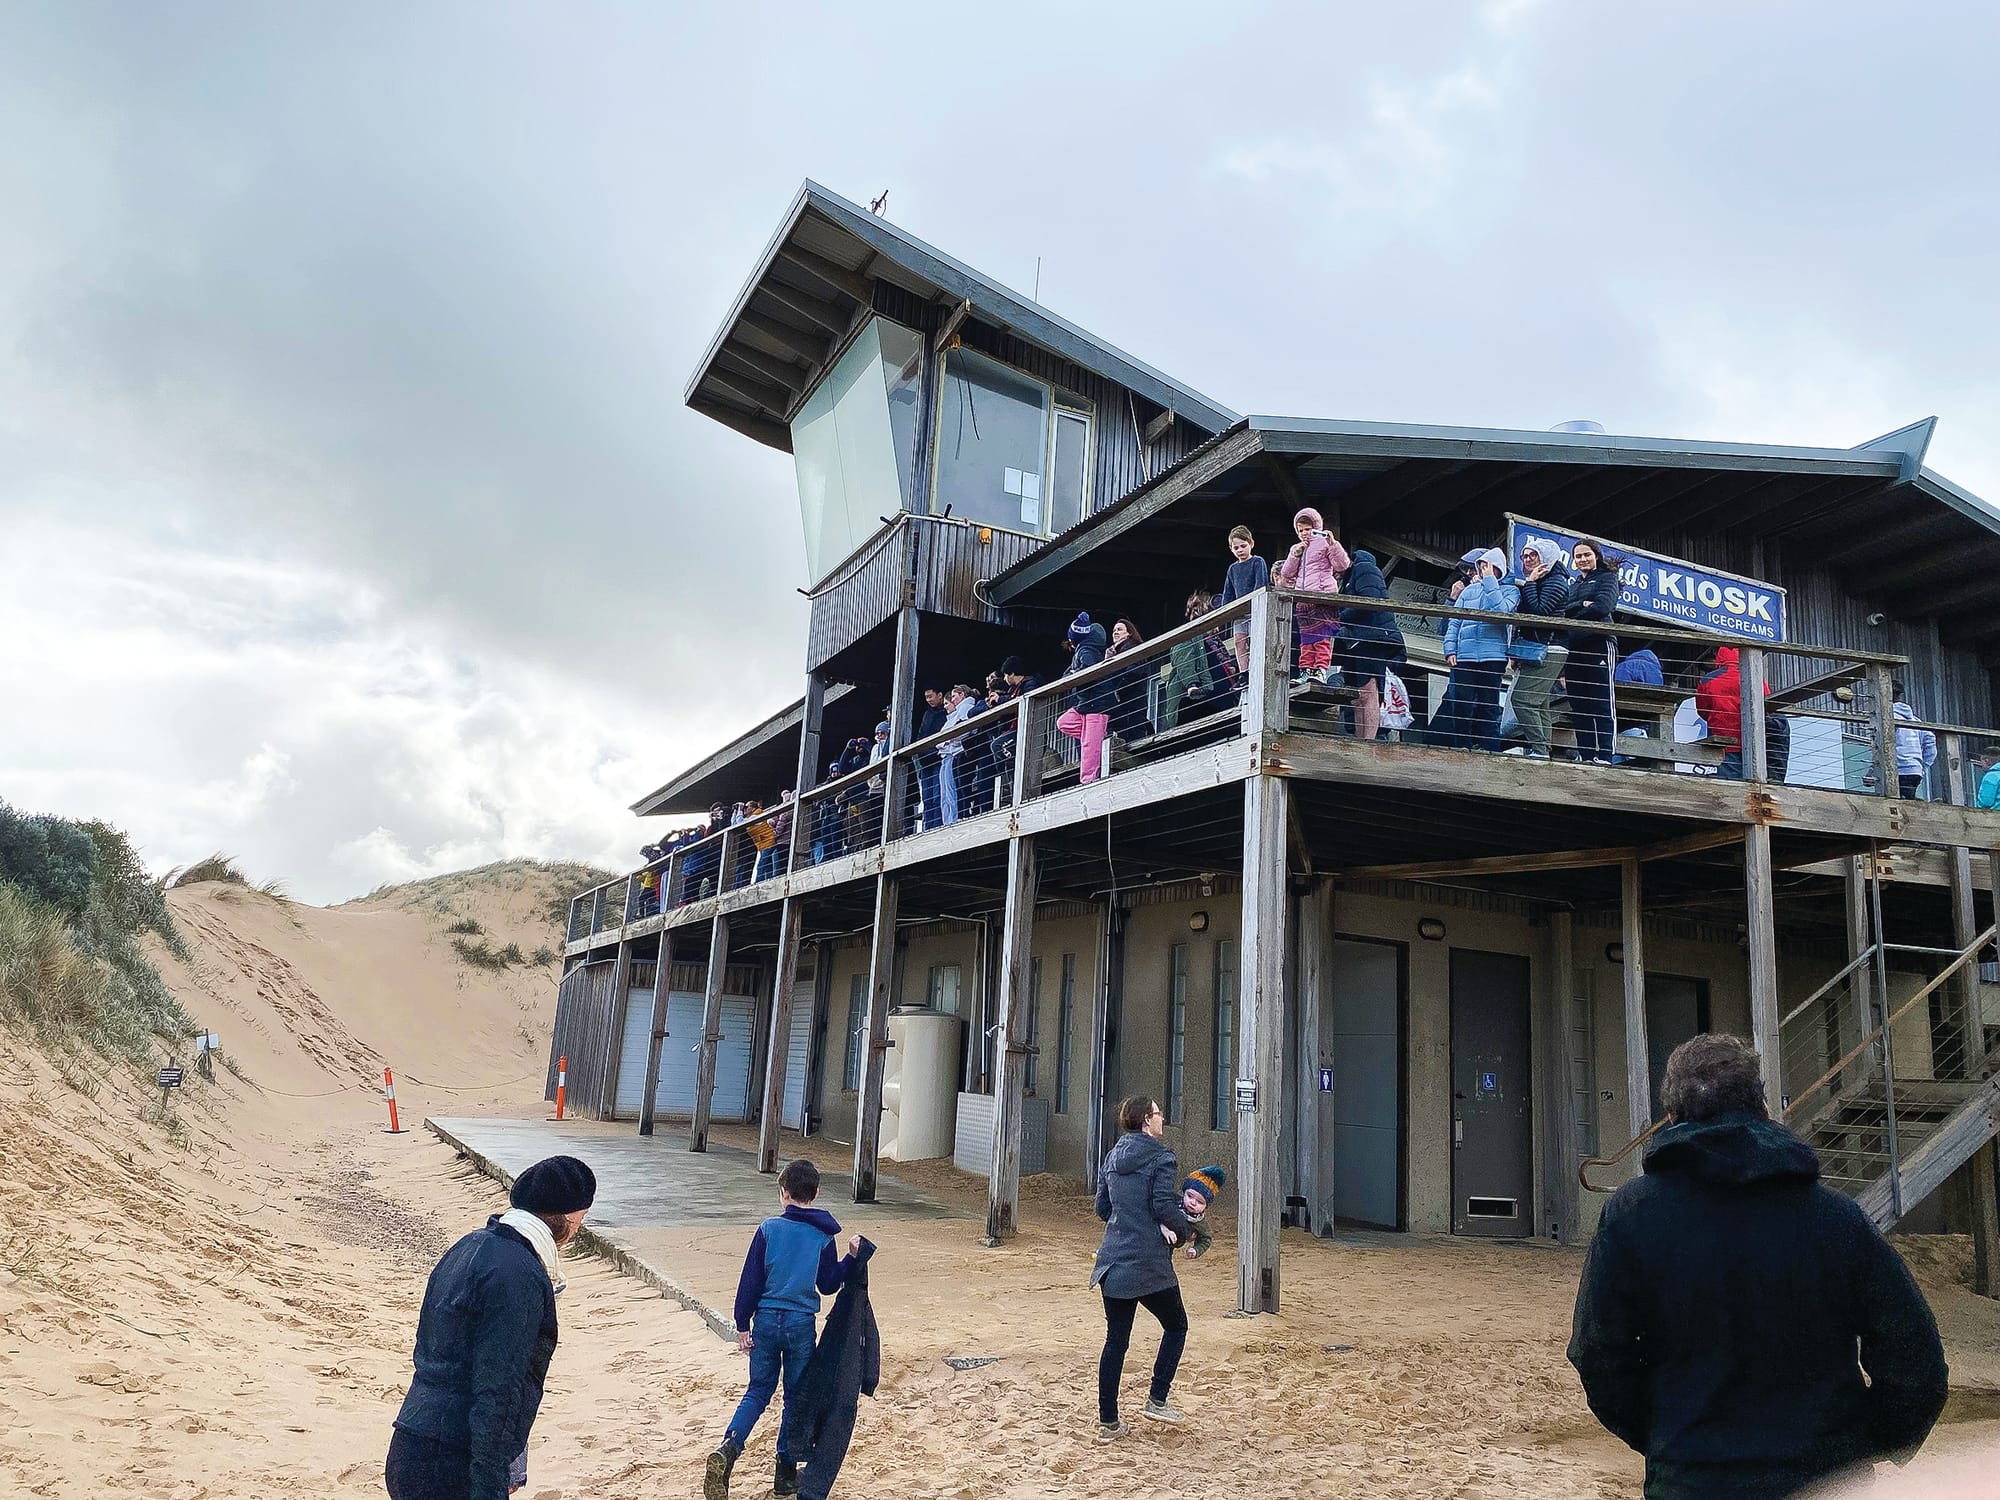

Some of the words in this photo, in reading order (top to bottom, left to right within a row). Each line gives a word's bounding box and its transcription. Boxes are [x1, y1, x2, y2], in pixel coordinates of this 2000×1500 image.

[1652, 598, 1697, 619] DRINKS
[1708, 611, 1775, 638] ICECREAMS
[1658, 568, 1773, 622] KIOSK
